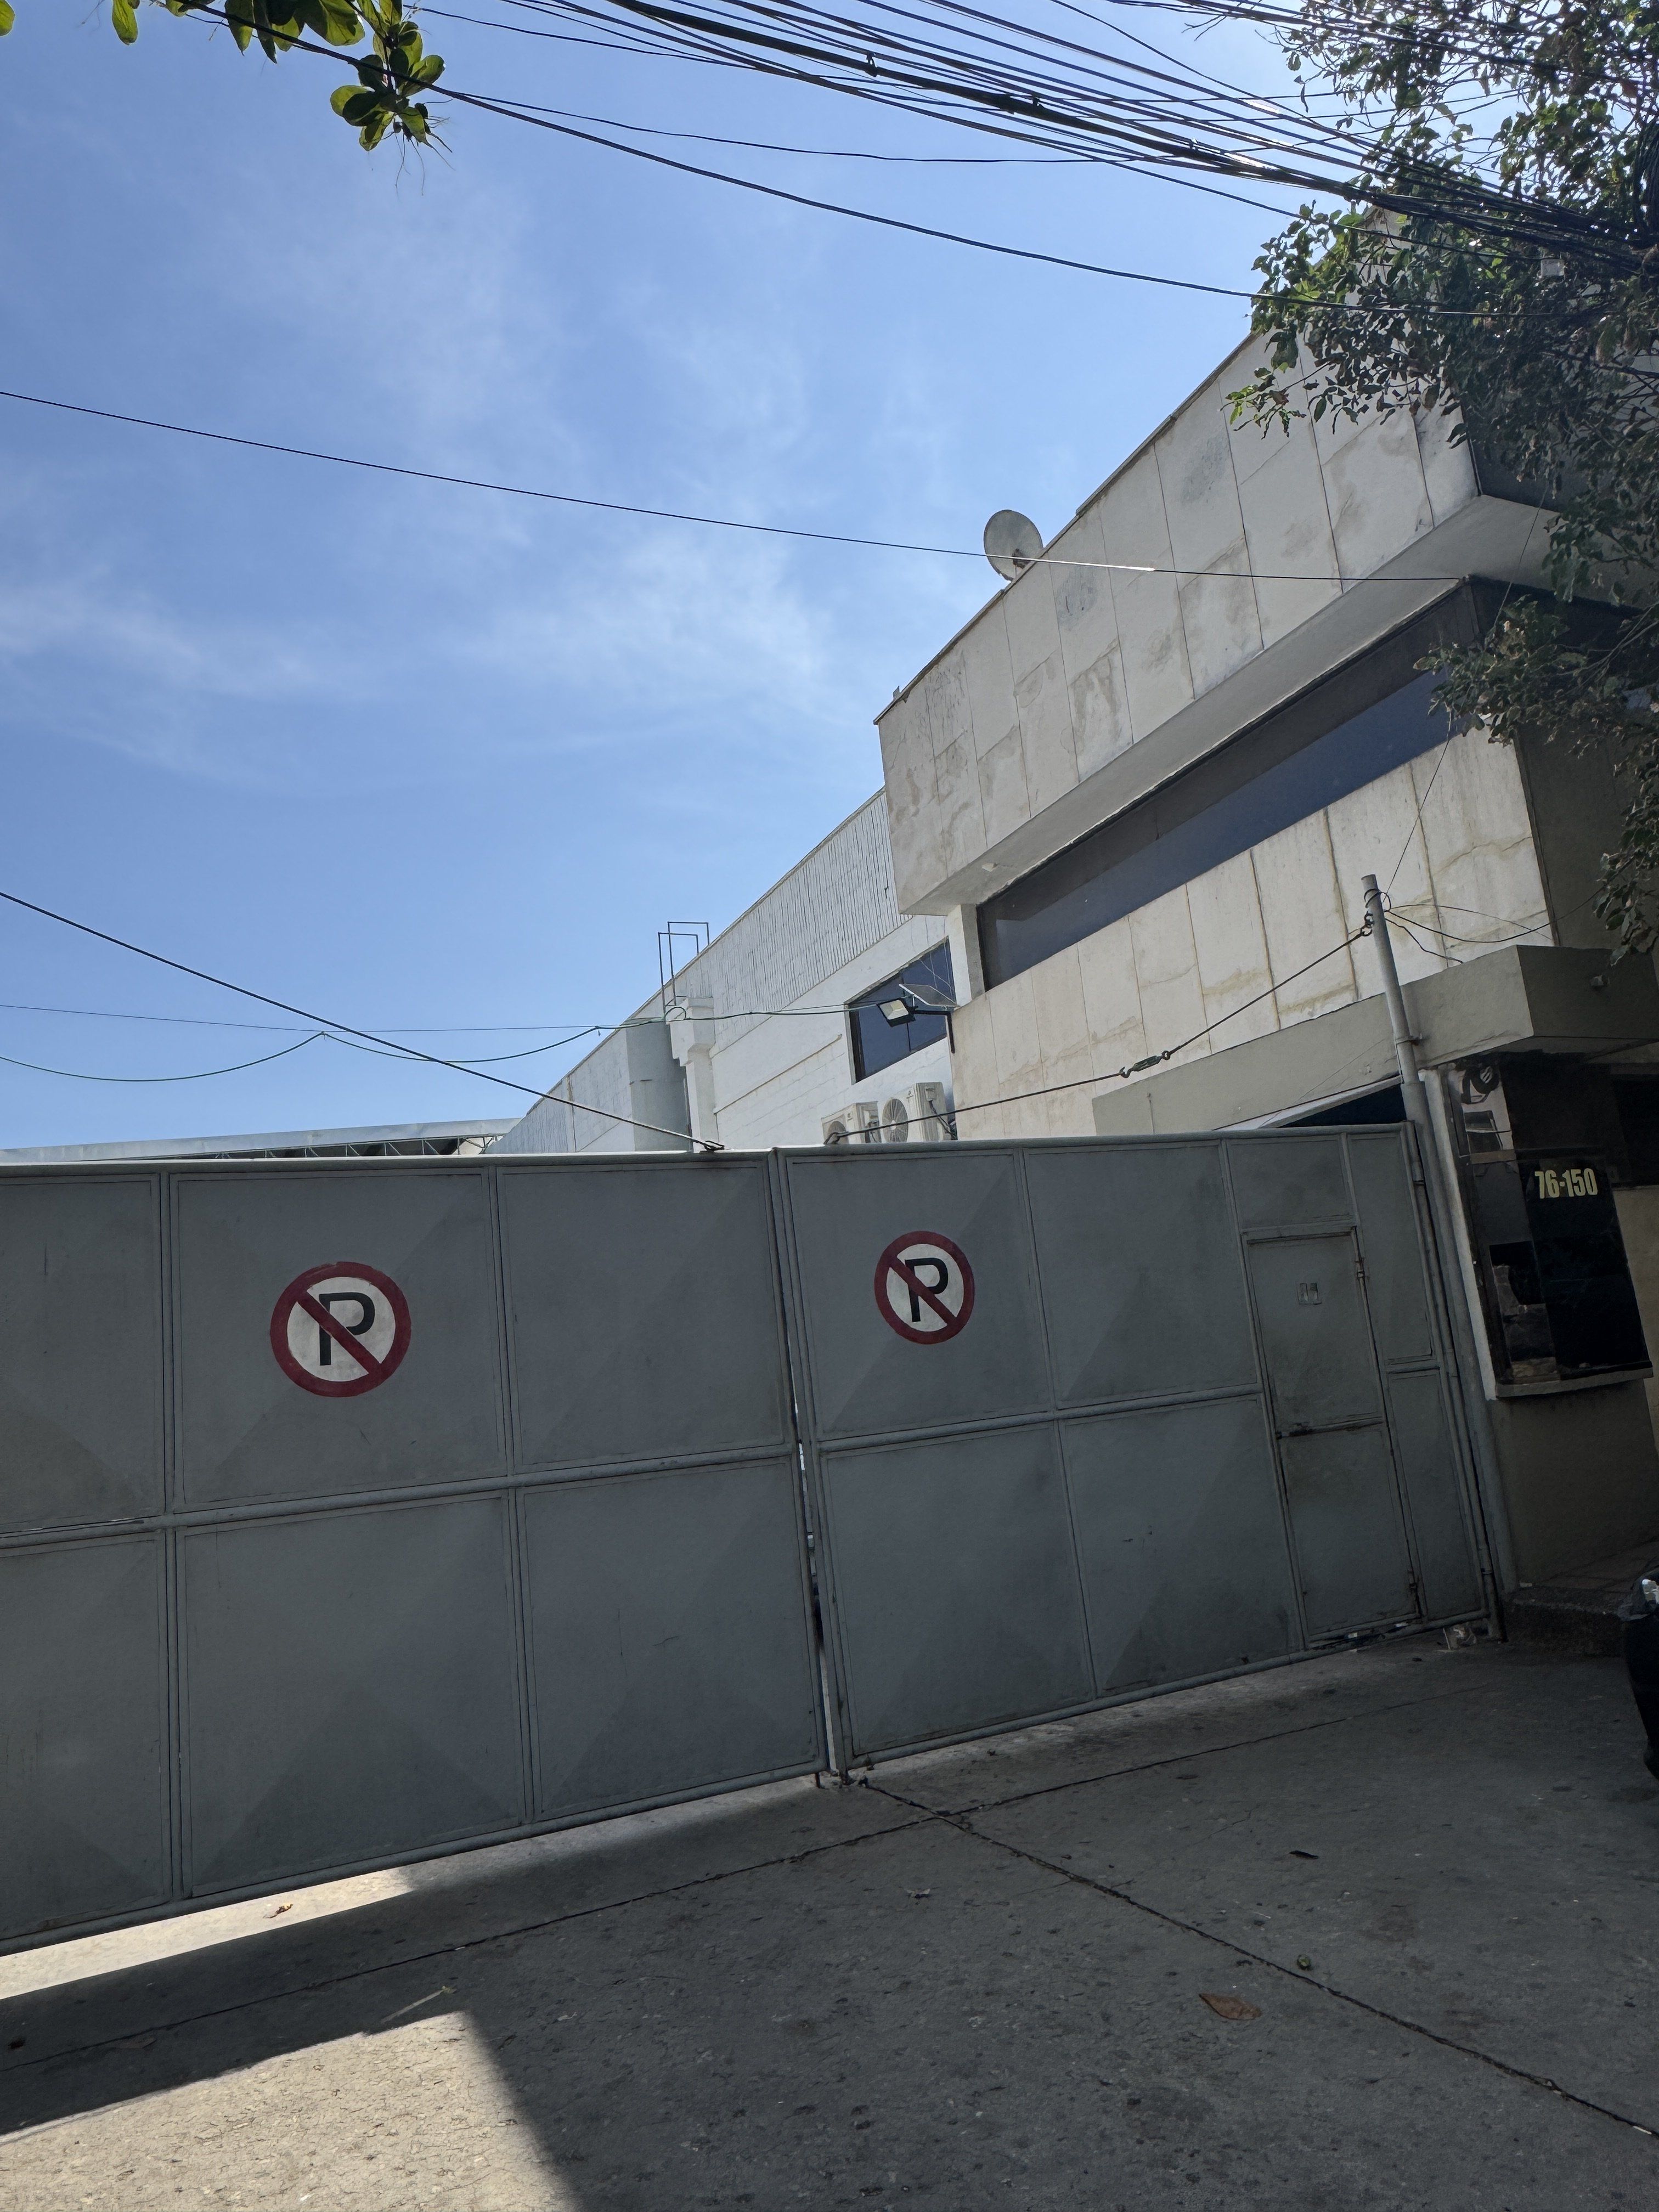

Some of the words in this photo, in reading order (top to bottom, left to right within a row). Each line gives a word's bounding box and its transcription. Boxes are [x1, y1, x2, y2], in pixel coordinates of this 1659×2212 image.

[1534, 1168, 1598, 1199] 76-150
[904, 1257, 949, 1323] P
[319, 1292, 375, 1366] P
